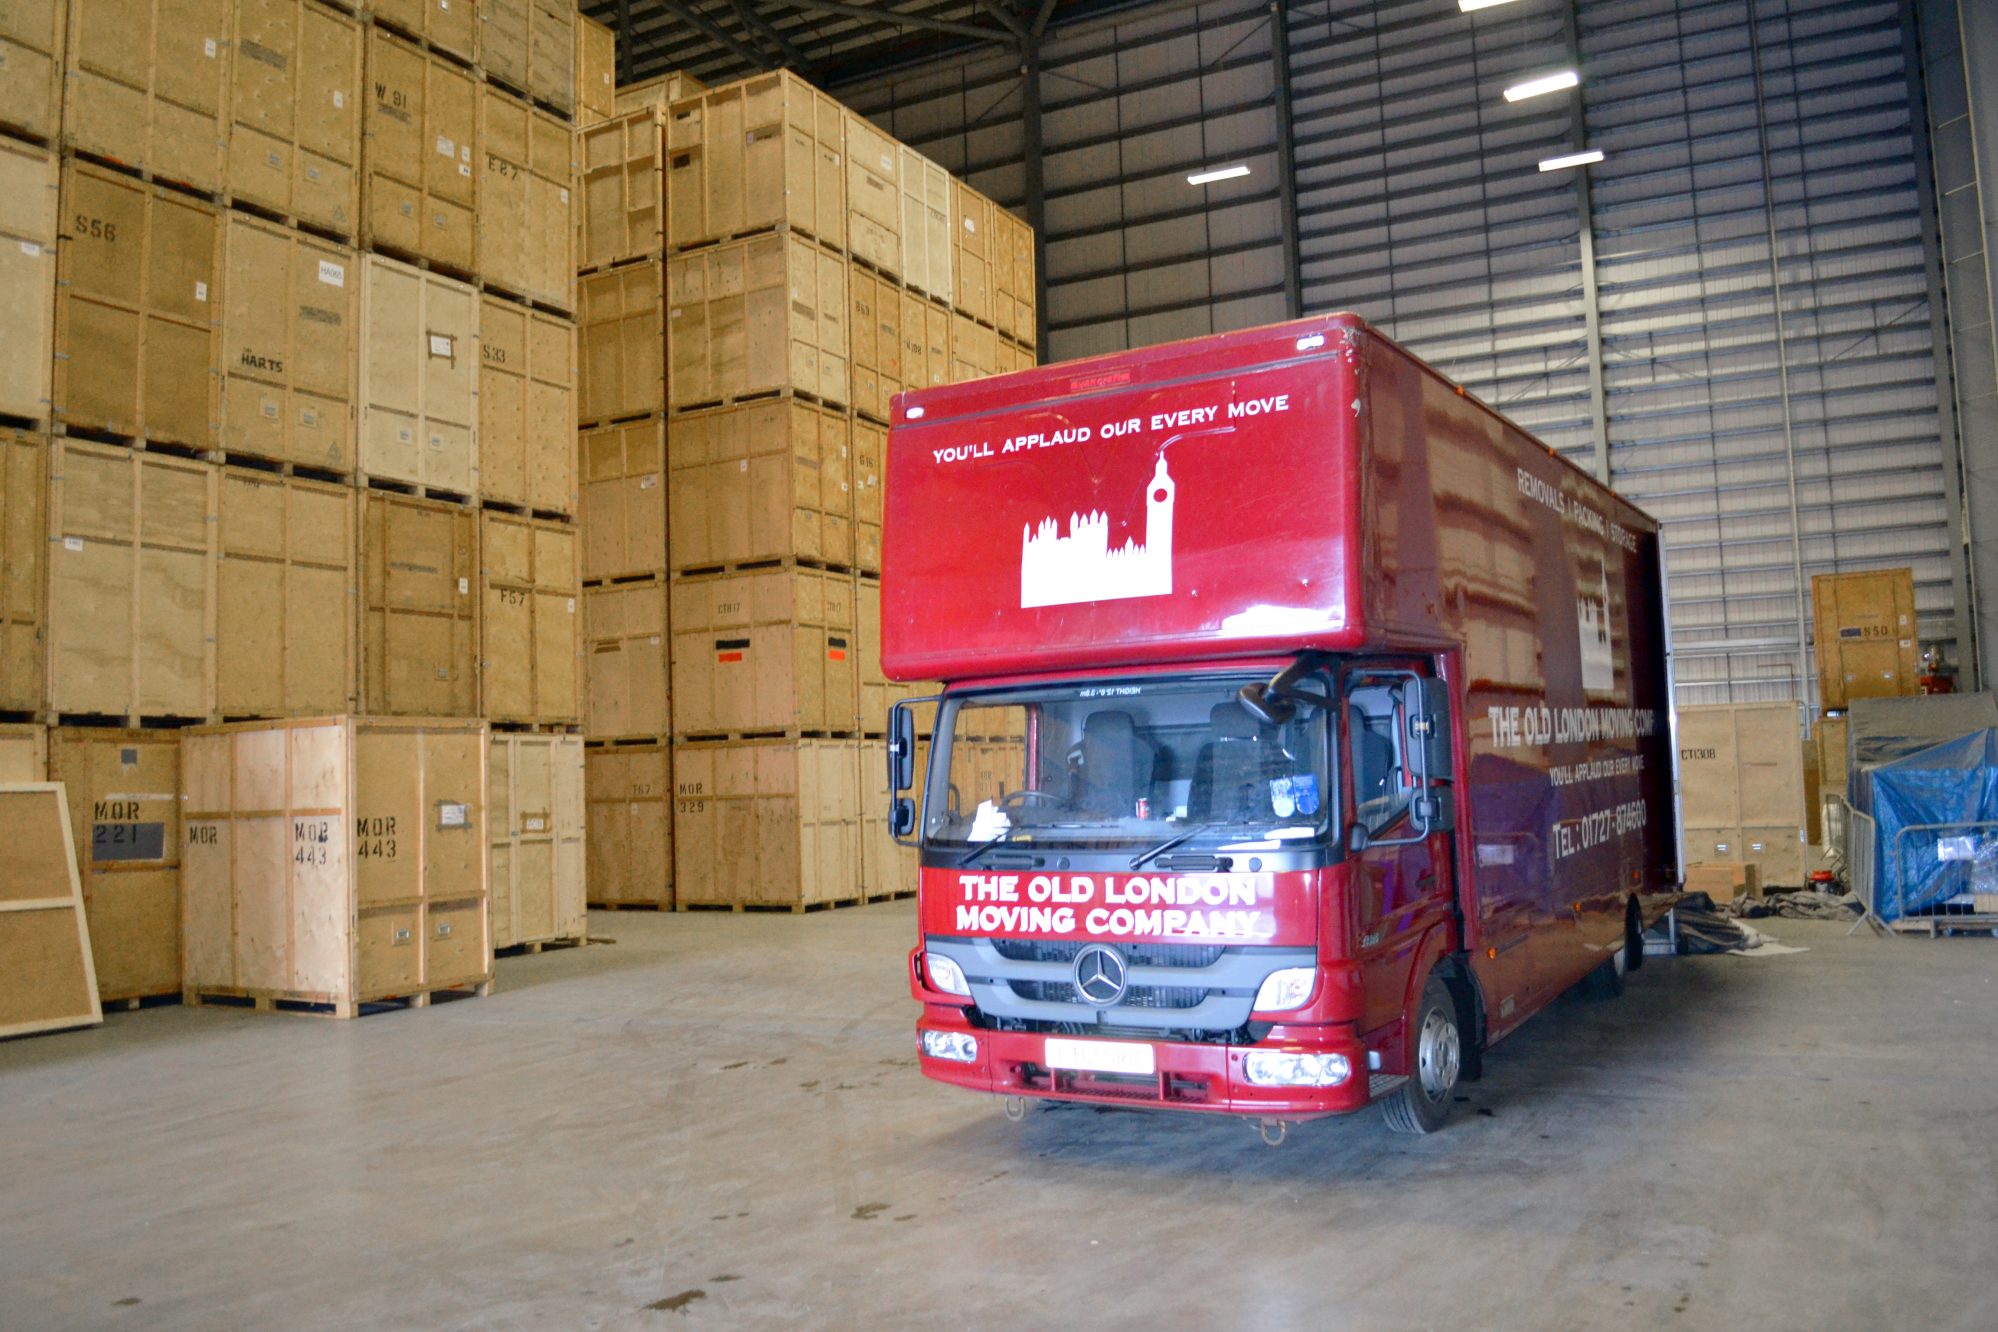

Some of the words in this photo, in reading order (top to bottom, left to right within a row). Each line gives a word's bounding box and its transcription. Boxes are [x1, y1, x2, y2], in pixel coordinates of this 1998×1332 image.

[76, 215, 116, 242] S56
[241, 353, 283, 373] HARTS
[483, 344, 506, 363] S33
[933, 440, 994, 464] YOU'LL
[1001, 427, 1091, 454] APPLAUD
[1100, 418, 1141, 440] OUR
[1151, 405, 1218, 431] EVERY
[1227, 395, 1290, 419] MOVE
[1517, 467, 1565, 514] REMOVALS
[1573, 501, 1604, 536] PACKING
[1488, 706, 1521, 748] THE
[1524, 706, 1551, 745] OLD
[1554, 708, 1599, 744] LONDON
[1601, 708, 1633, 739] MOVING
[1549, 764, 1574, 787] YOU'LL
[1575, 761, 1602, 782] APPLAUD
[1603, 759, 1615, 778] OUR
[680, 783, 703, 795] MOR
[94, 801, 140, 820] MOR
[680, 802, 704, 814] 329
[95, 825, 137, 843] 221
[189, 826, 218, 844] MOR
[357, 817, 396, 836] MOR
[295, 846, 327, 865] 443
[358, 840, 396, 859] 443
[959, 875, 1019, 902] THE
[1027, 875, 1095, 903] OLD
[1104, 876, 1258, 905] LONDON
[955, 905, 1076, 934] MOVING
[1085, 908, 1262, 938] COMPANY
